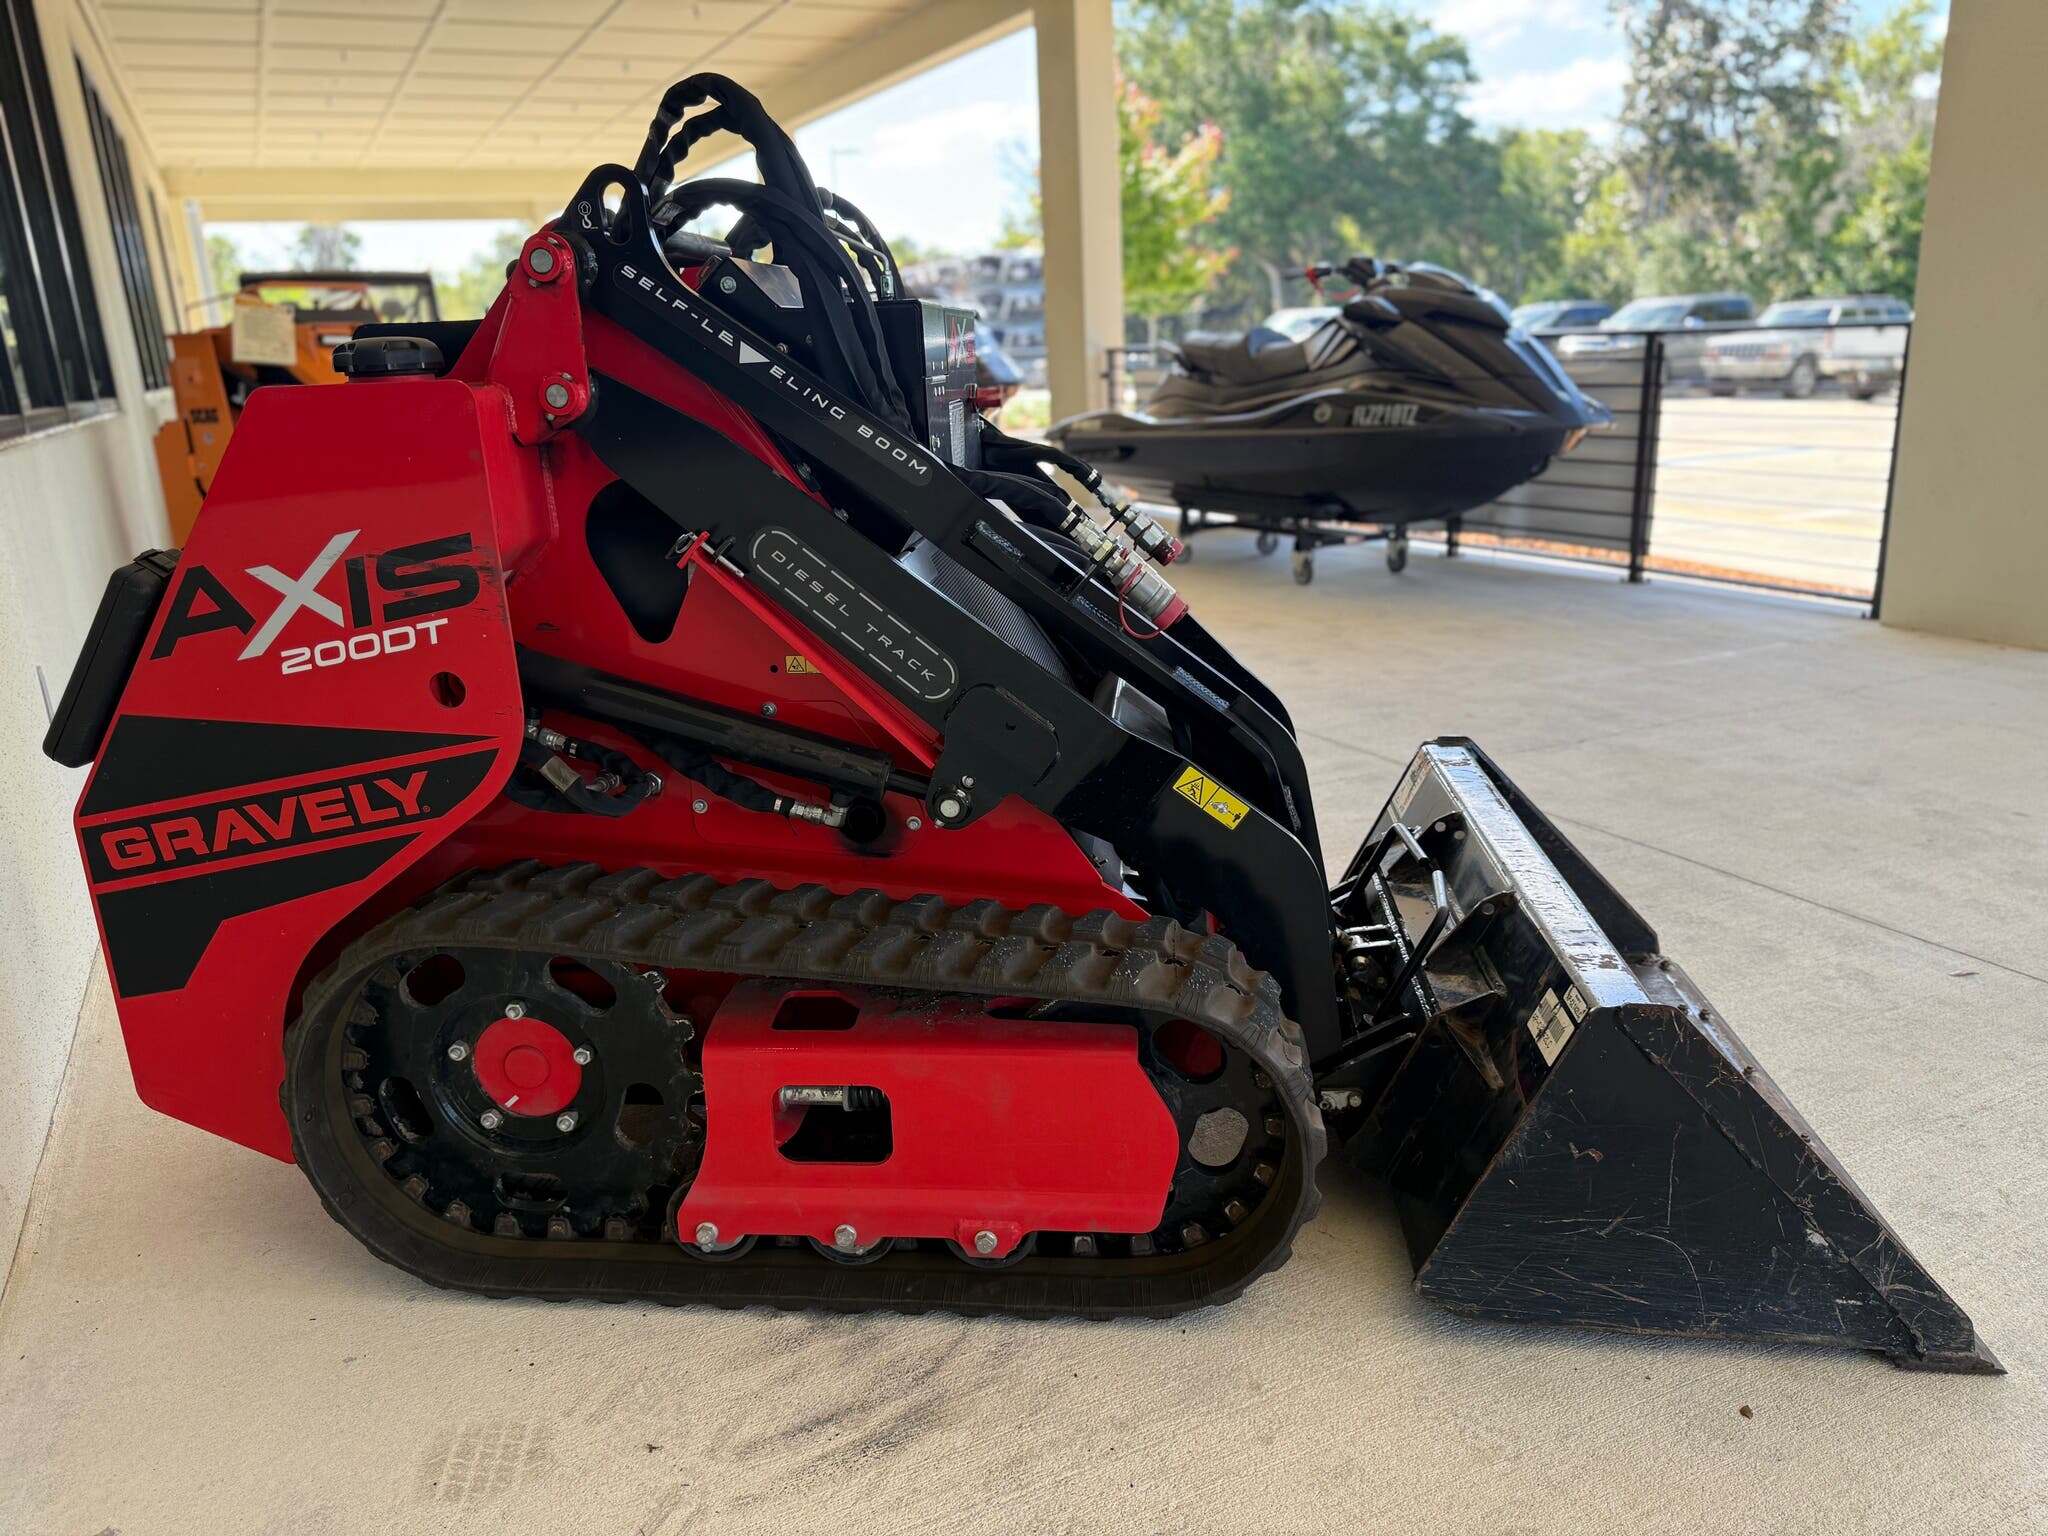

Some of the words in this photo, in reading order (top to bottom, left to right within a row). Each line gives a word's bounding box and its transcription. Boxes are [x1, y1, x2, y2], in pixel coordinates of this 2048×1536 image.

[857, 424, 928, 475] BOOM
[150, 528, 481, 662] AXIS
[770, 550, 850, 617] DIESEL
[864, 622, 936, 683] TRACK
[280, 617, 449, 675] 200DT
[100, 770, 430, 871] GRAVELY
